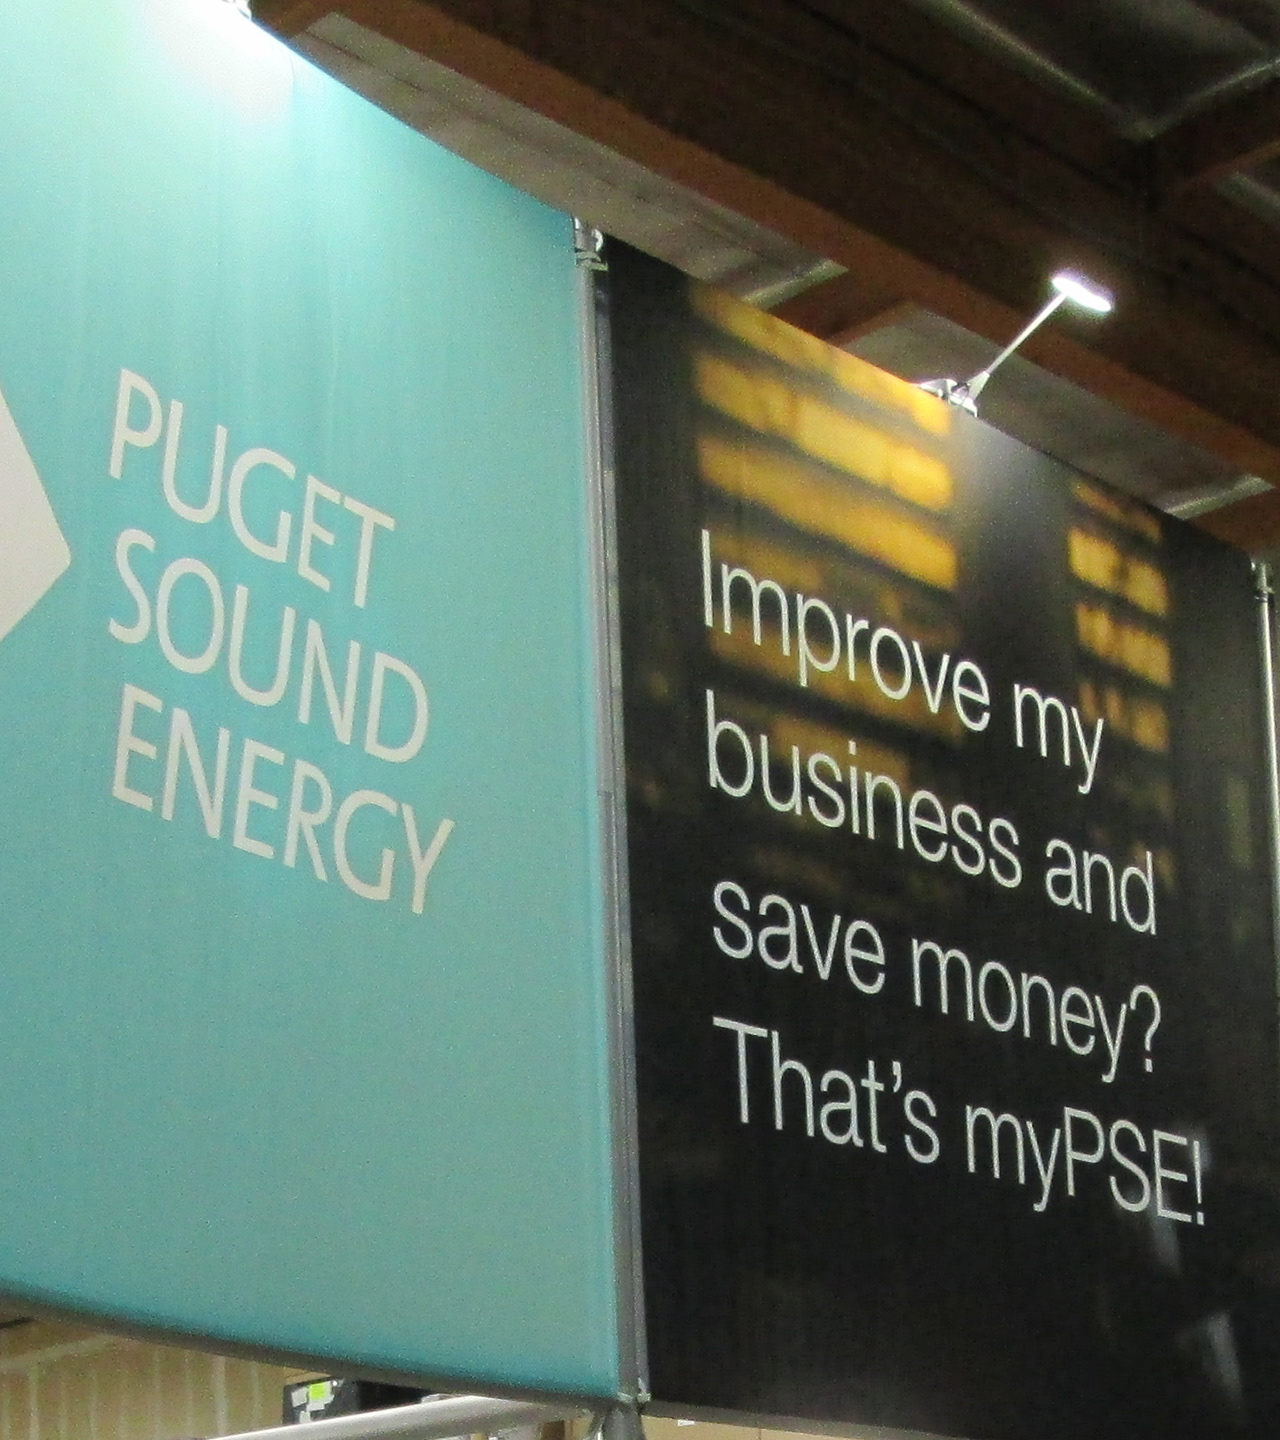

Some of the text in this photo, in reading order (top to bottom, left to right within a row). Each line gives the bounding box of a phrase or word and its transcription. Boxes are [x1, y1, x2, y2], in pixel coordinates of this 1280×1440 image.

[108, 368, 395, 607] PUGET
[108, 528, 429, 763] SOUND
[701, 530, 1104, 794] Improve my
[111, 683, 455, 914] ENERGY
[705, 690, 1157, 934] business and
[712, 881, 1162, 1083] save money?
[712, 1016, 1205, 1226] That's myPSE!
